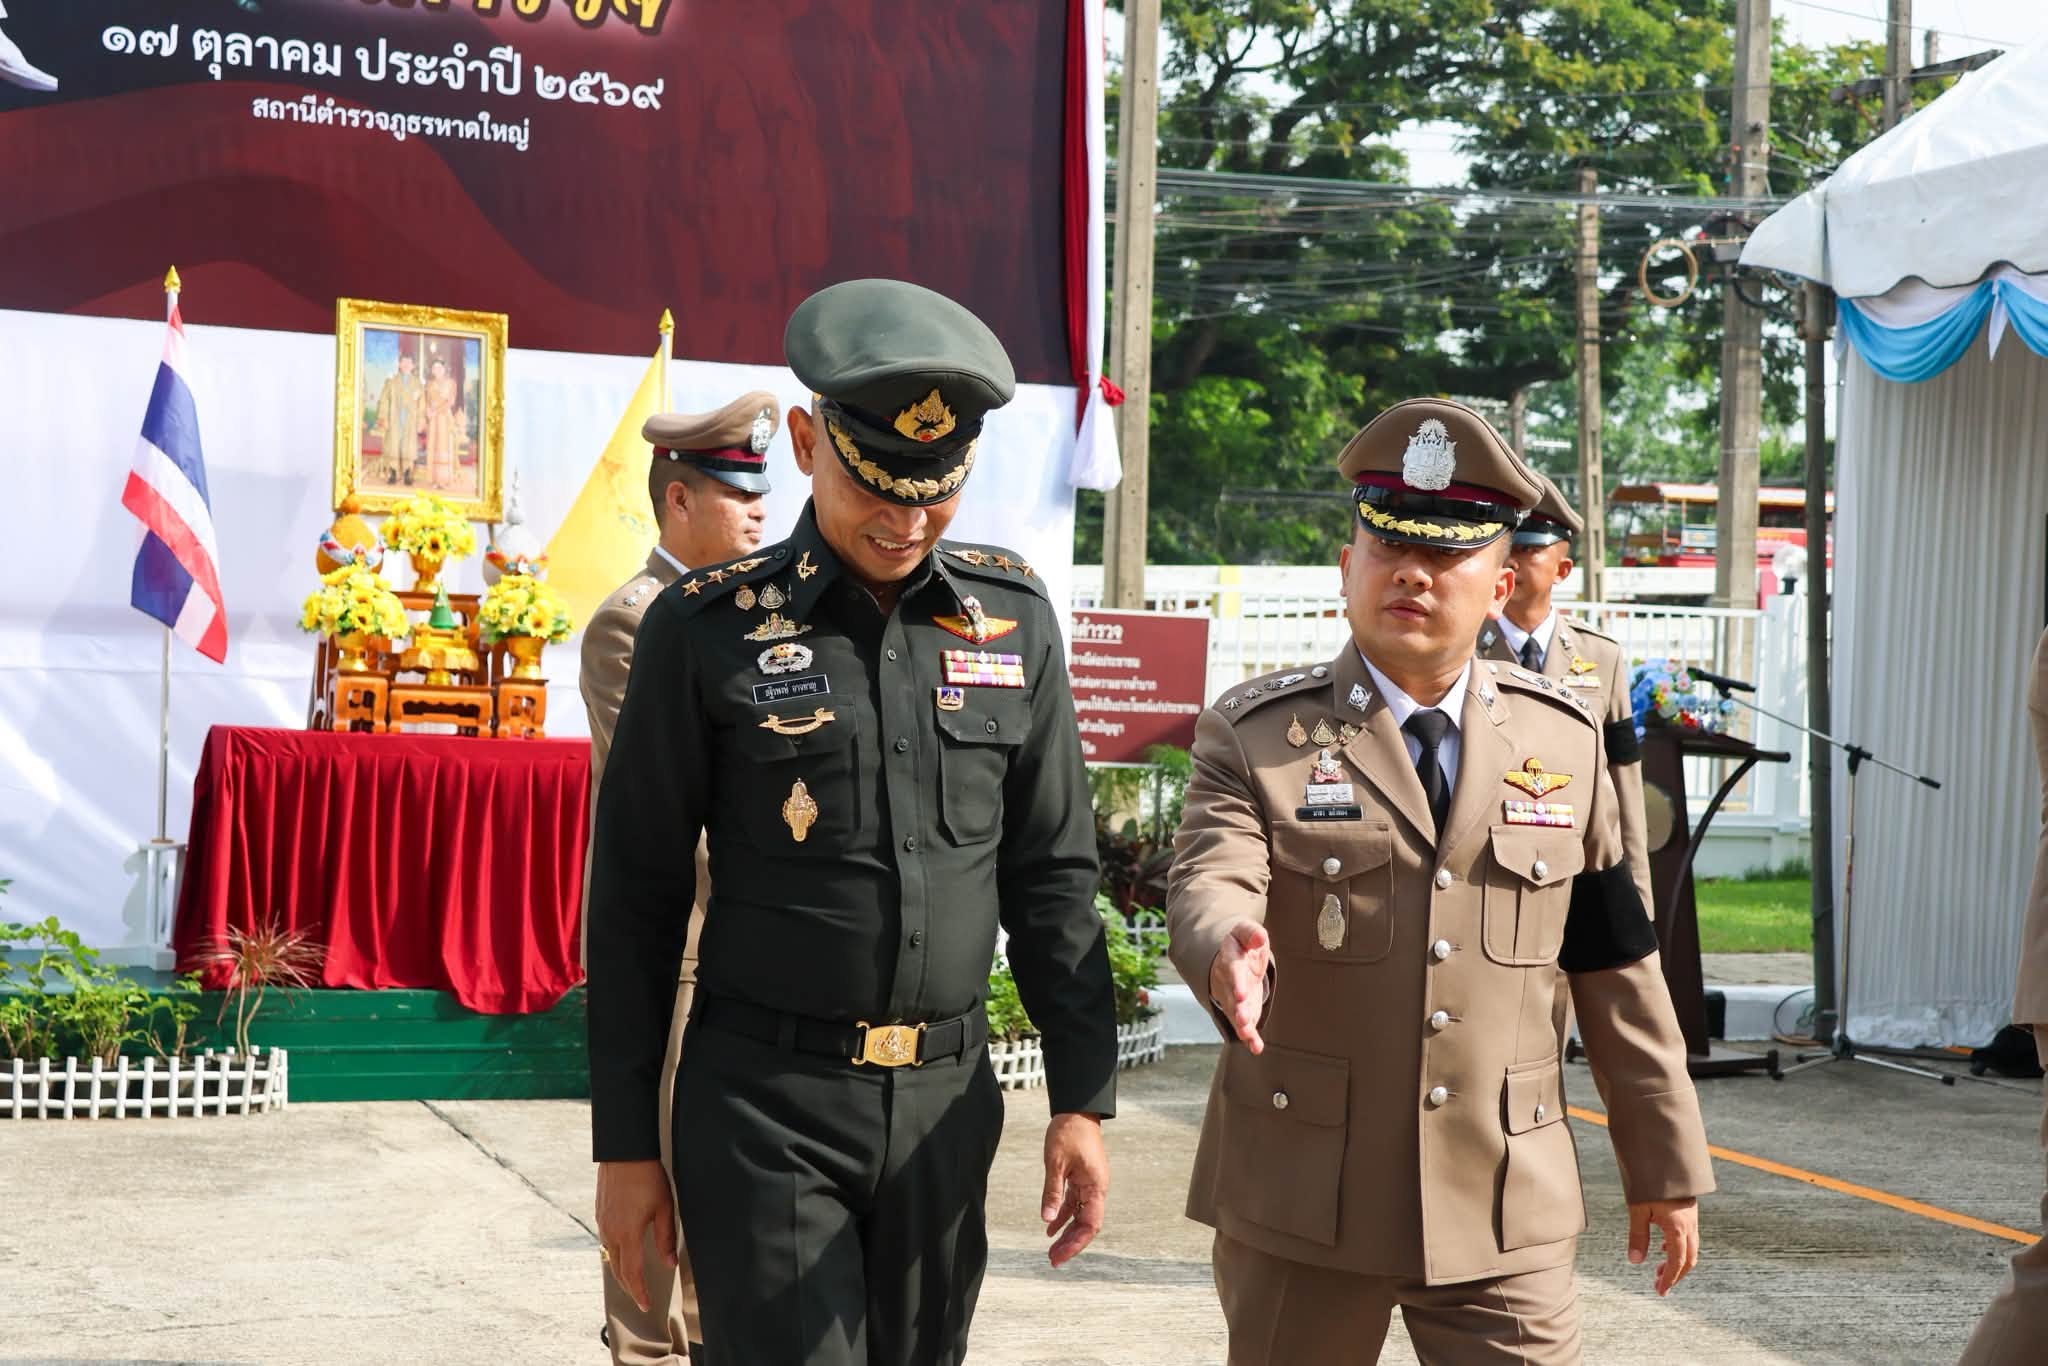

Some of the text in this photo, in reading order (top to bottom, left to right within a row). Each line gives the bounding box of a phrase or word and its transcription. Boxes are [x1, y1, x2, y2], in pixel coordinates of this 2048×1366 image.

[102, 24, 664, 110] ๑๗ ตุลาคม ประจำปี ๒๕๖๙
[252, 95, 530, 152] สถานีตำรวจภูธรหาดใหญ่
